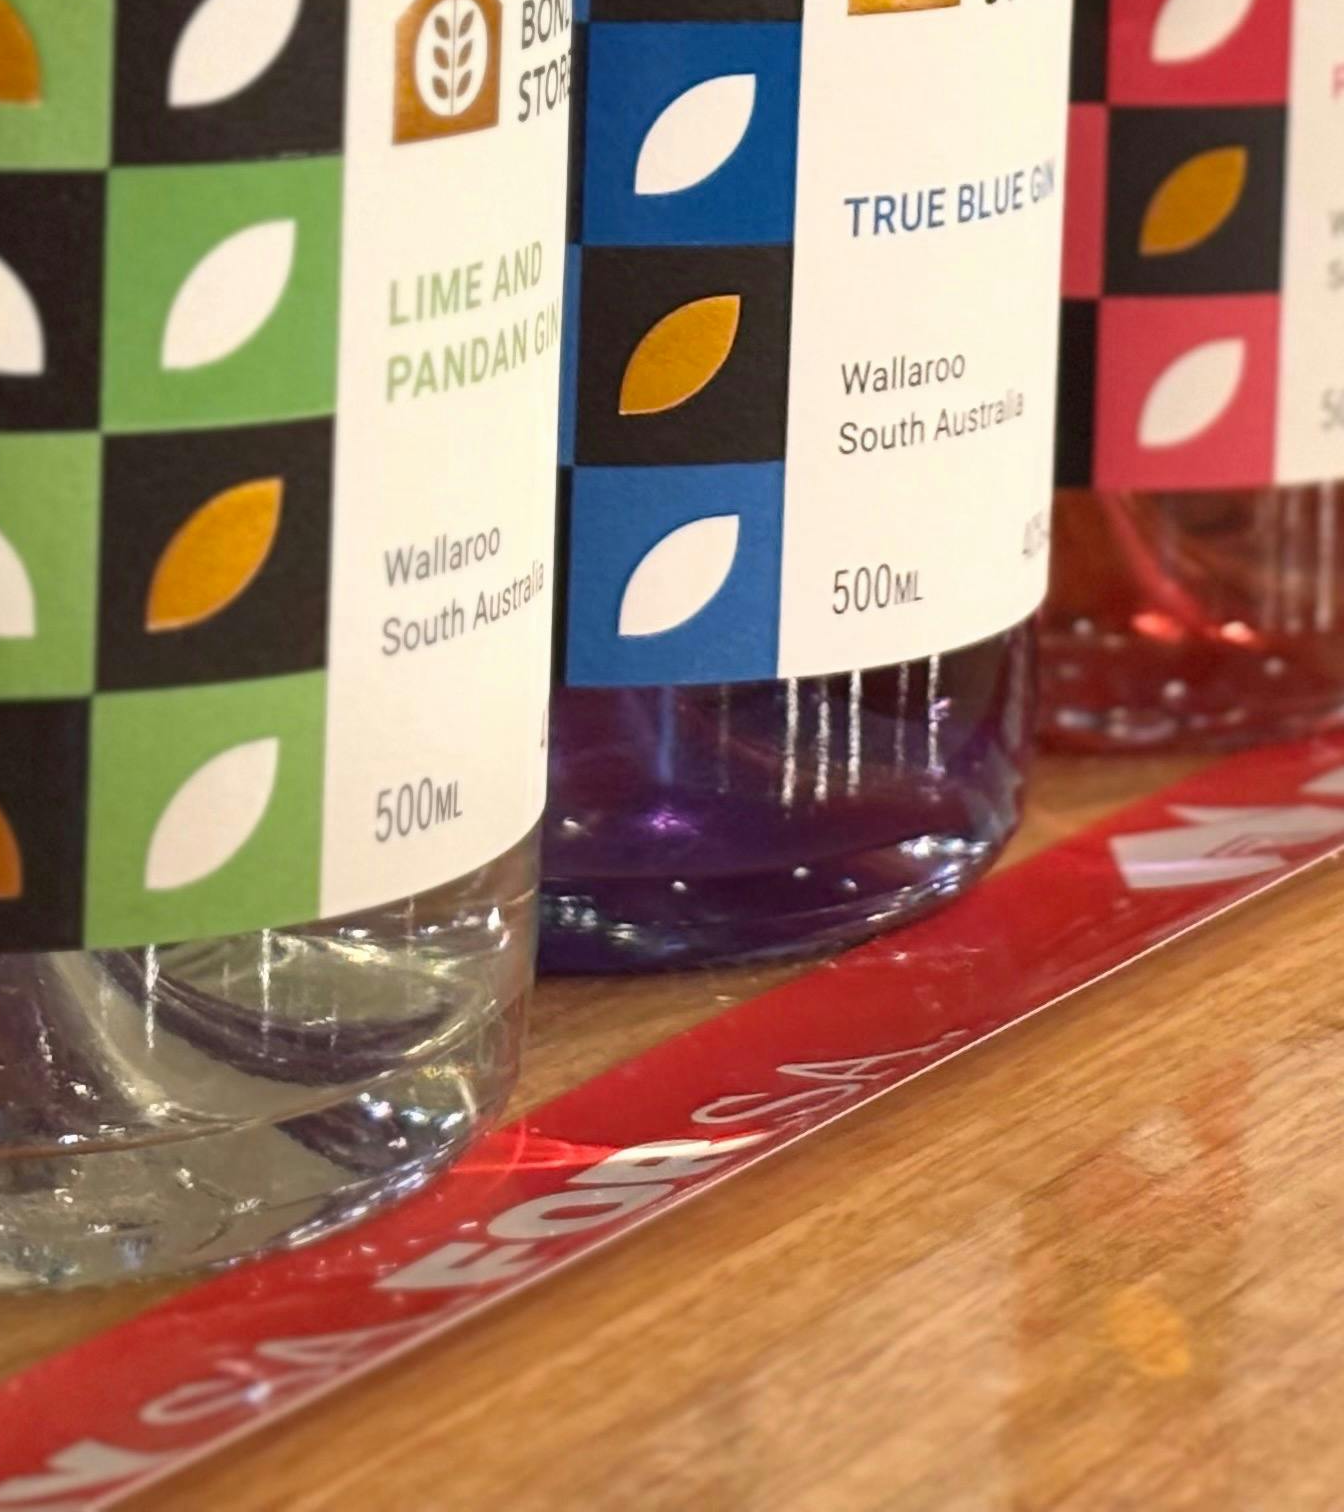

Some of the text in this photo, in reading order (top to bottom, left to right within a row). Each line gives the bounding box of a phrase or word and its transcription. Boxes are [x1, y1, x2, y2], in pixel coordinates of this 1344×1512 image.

[843, 187, 947, 238] TRUE
[957, 171, 1025, 224] BLUE
[388, 240, 543, 328] LIME AND
[386, 296, 559, 404] PANDAN GIN
[841, 354, 966, 396] Wallaroo
[838, 388, 1025, 456] South Australia
[384, 526, 501, 588] Wallaroo
[832, 562, 924, 615] 500ML
[381, 559, 545, 657] South Australia
[375, 776, 463, 843] 500ML
[372, 1138, 771, 1290] FOR
